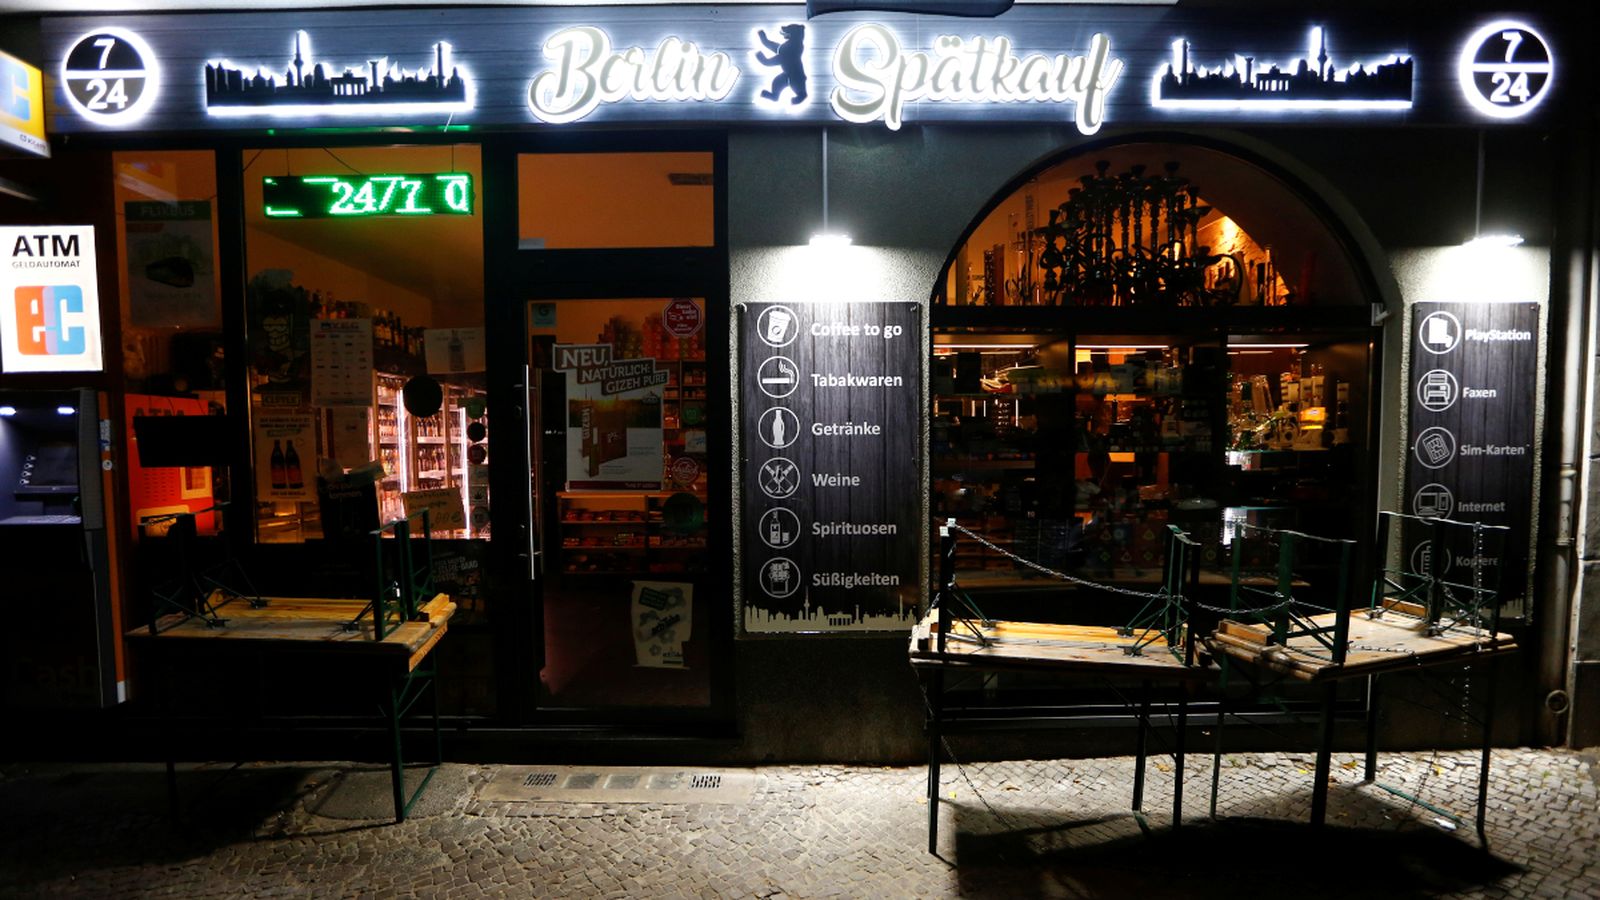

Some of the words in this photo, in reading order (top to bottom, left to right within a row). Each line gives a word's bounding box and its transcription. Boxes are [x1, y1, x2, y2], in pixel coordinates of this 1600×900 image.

[93, 38, 116, 71] 7
[1502, 31, 1522, 64] 7
[530, 23, 741, 123] Berlin
[830, 21, 1124, 135] Spätkauf
[86, 78, 129, 110] 24
[1490, 71, 1531, 103] 24
[12, 234, 80, 257] ATM
[12, 259, 81, 269] GELDAUTOMAT
[811, 322, 860, 336] Coffee
[864, 323, 880, 336] to
[884, 324, 903, 339] go
[1464, 328, 1532, 343] PlayStation
[560, 348, 609, 368] NEU,
[606, 379, 641, 394] GIZEH
[643, 373, 667, 386] PURE
[811, 373, 903, 387] Tabakwaren
[1462, 387, 1497, 398] Faxen
[811, 422, 881, 436] Getränke
[1460, 444, 1525, 456] Sim-Karten
[812, 473, 861, 487] Weine
[1458, 501, 1506, 512] Internet
[812, 522, 897, 538] Spirituosen
[812, 572, 900, 589] Süßigkeiten
